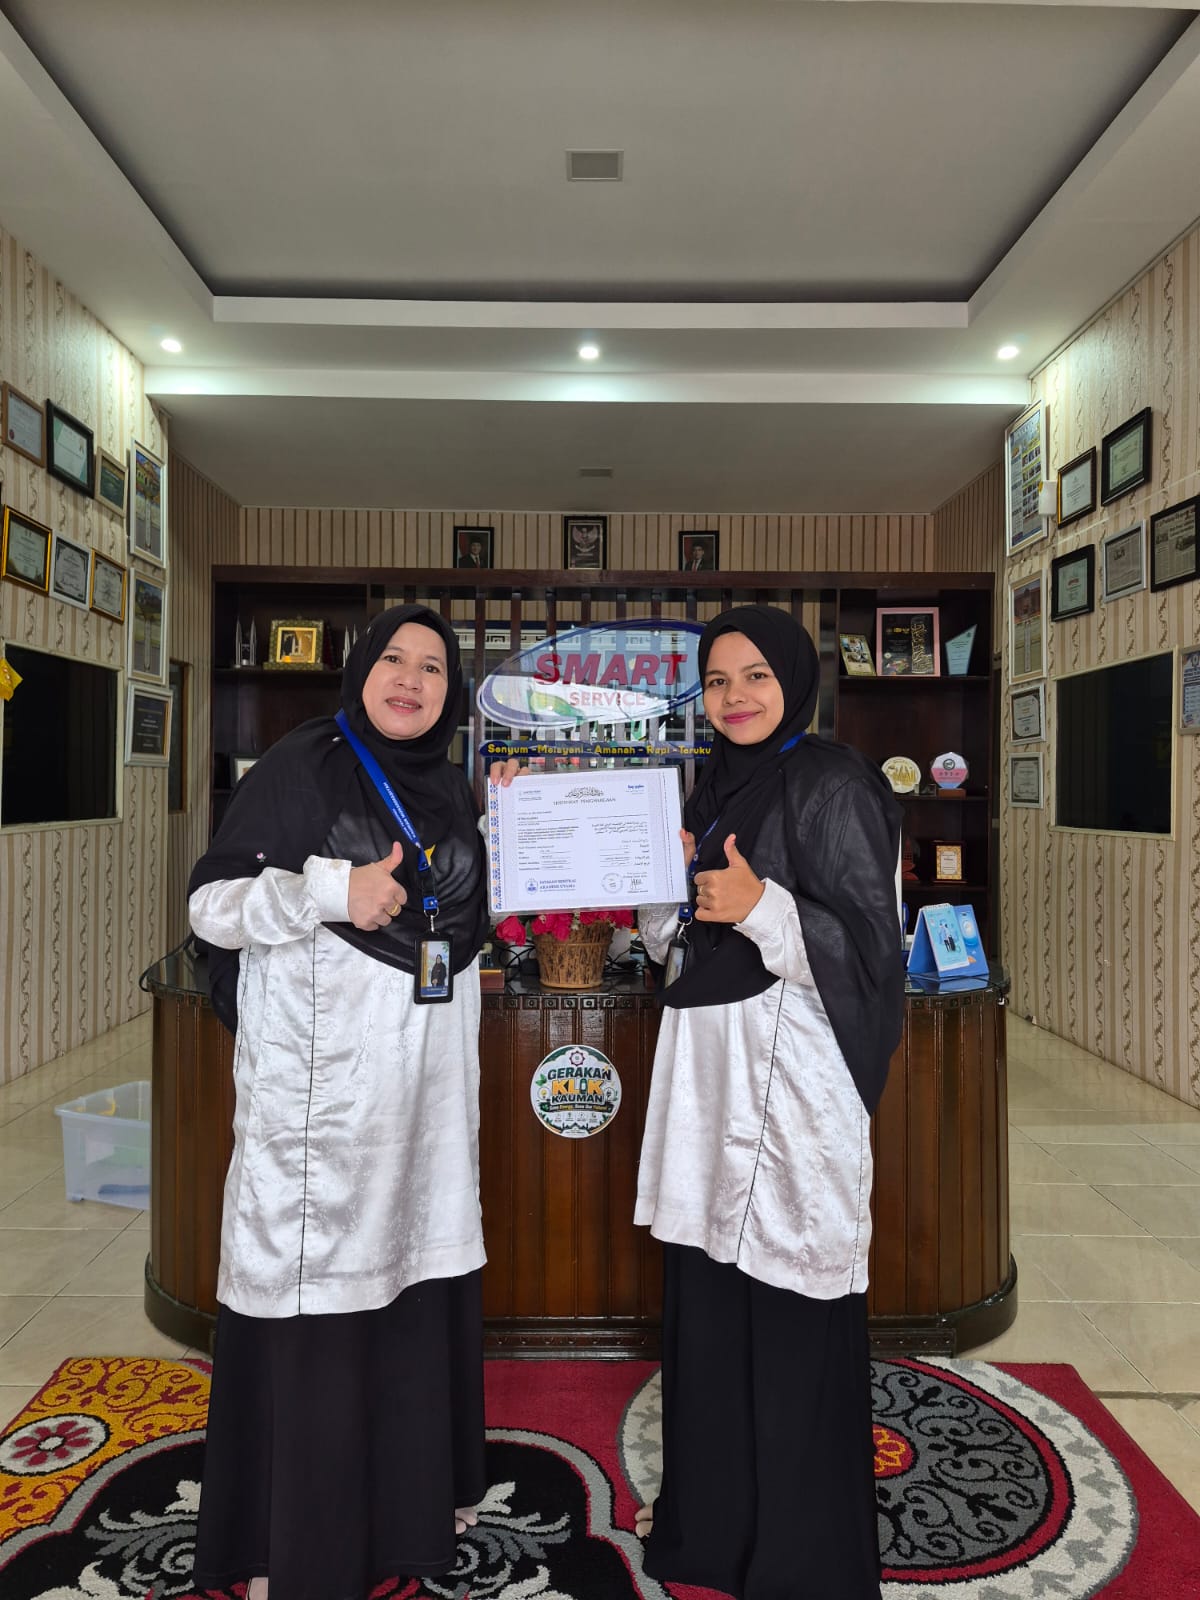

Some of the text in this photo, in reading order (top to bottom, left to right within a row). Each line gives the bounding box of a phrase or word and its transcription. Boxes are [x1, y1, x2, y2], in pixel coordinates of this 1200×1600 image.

[532, 653, 688, 686] SMART
[569, 691, 646, 707] SERVICE
[487, 744, 528, 756] Senyum
[594, 744, 635, 754] Amanah
[646, 744, 670, 756] Rapi
[548, 1067, 611, 1080] GERAKAN
[551, 1094, 603, 1103] KAUMAN
